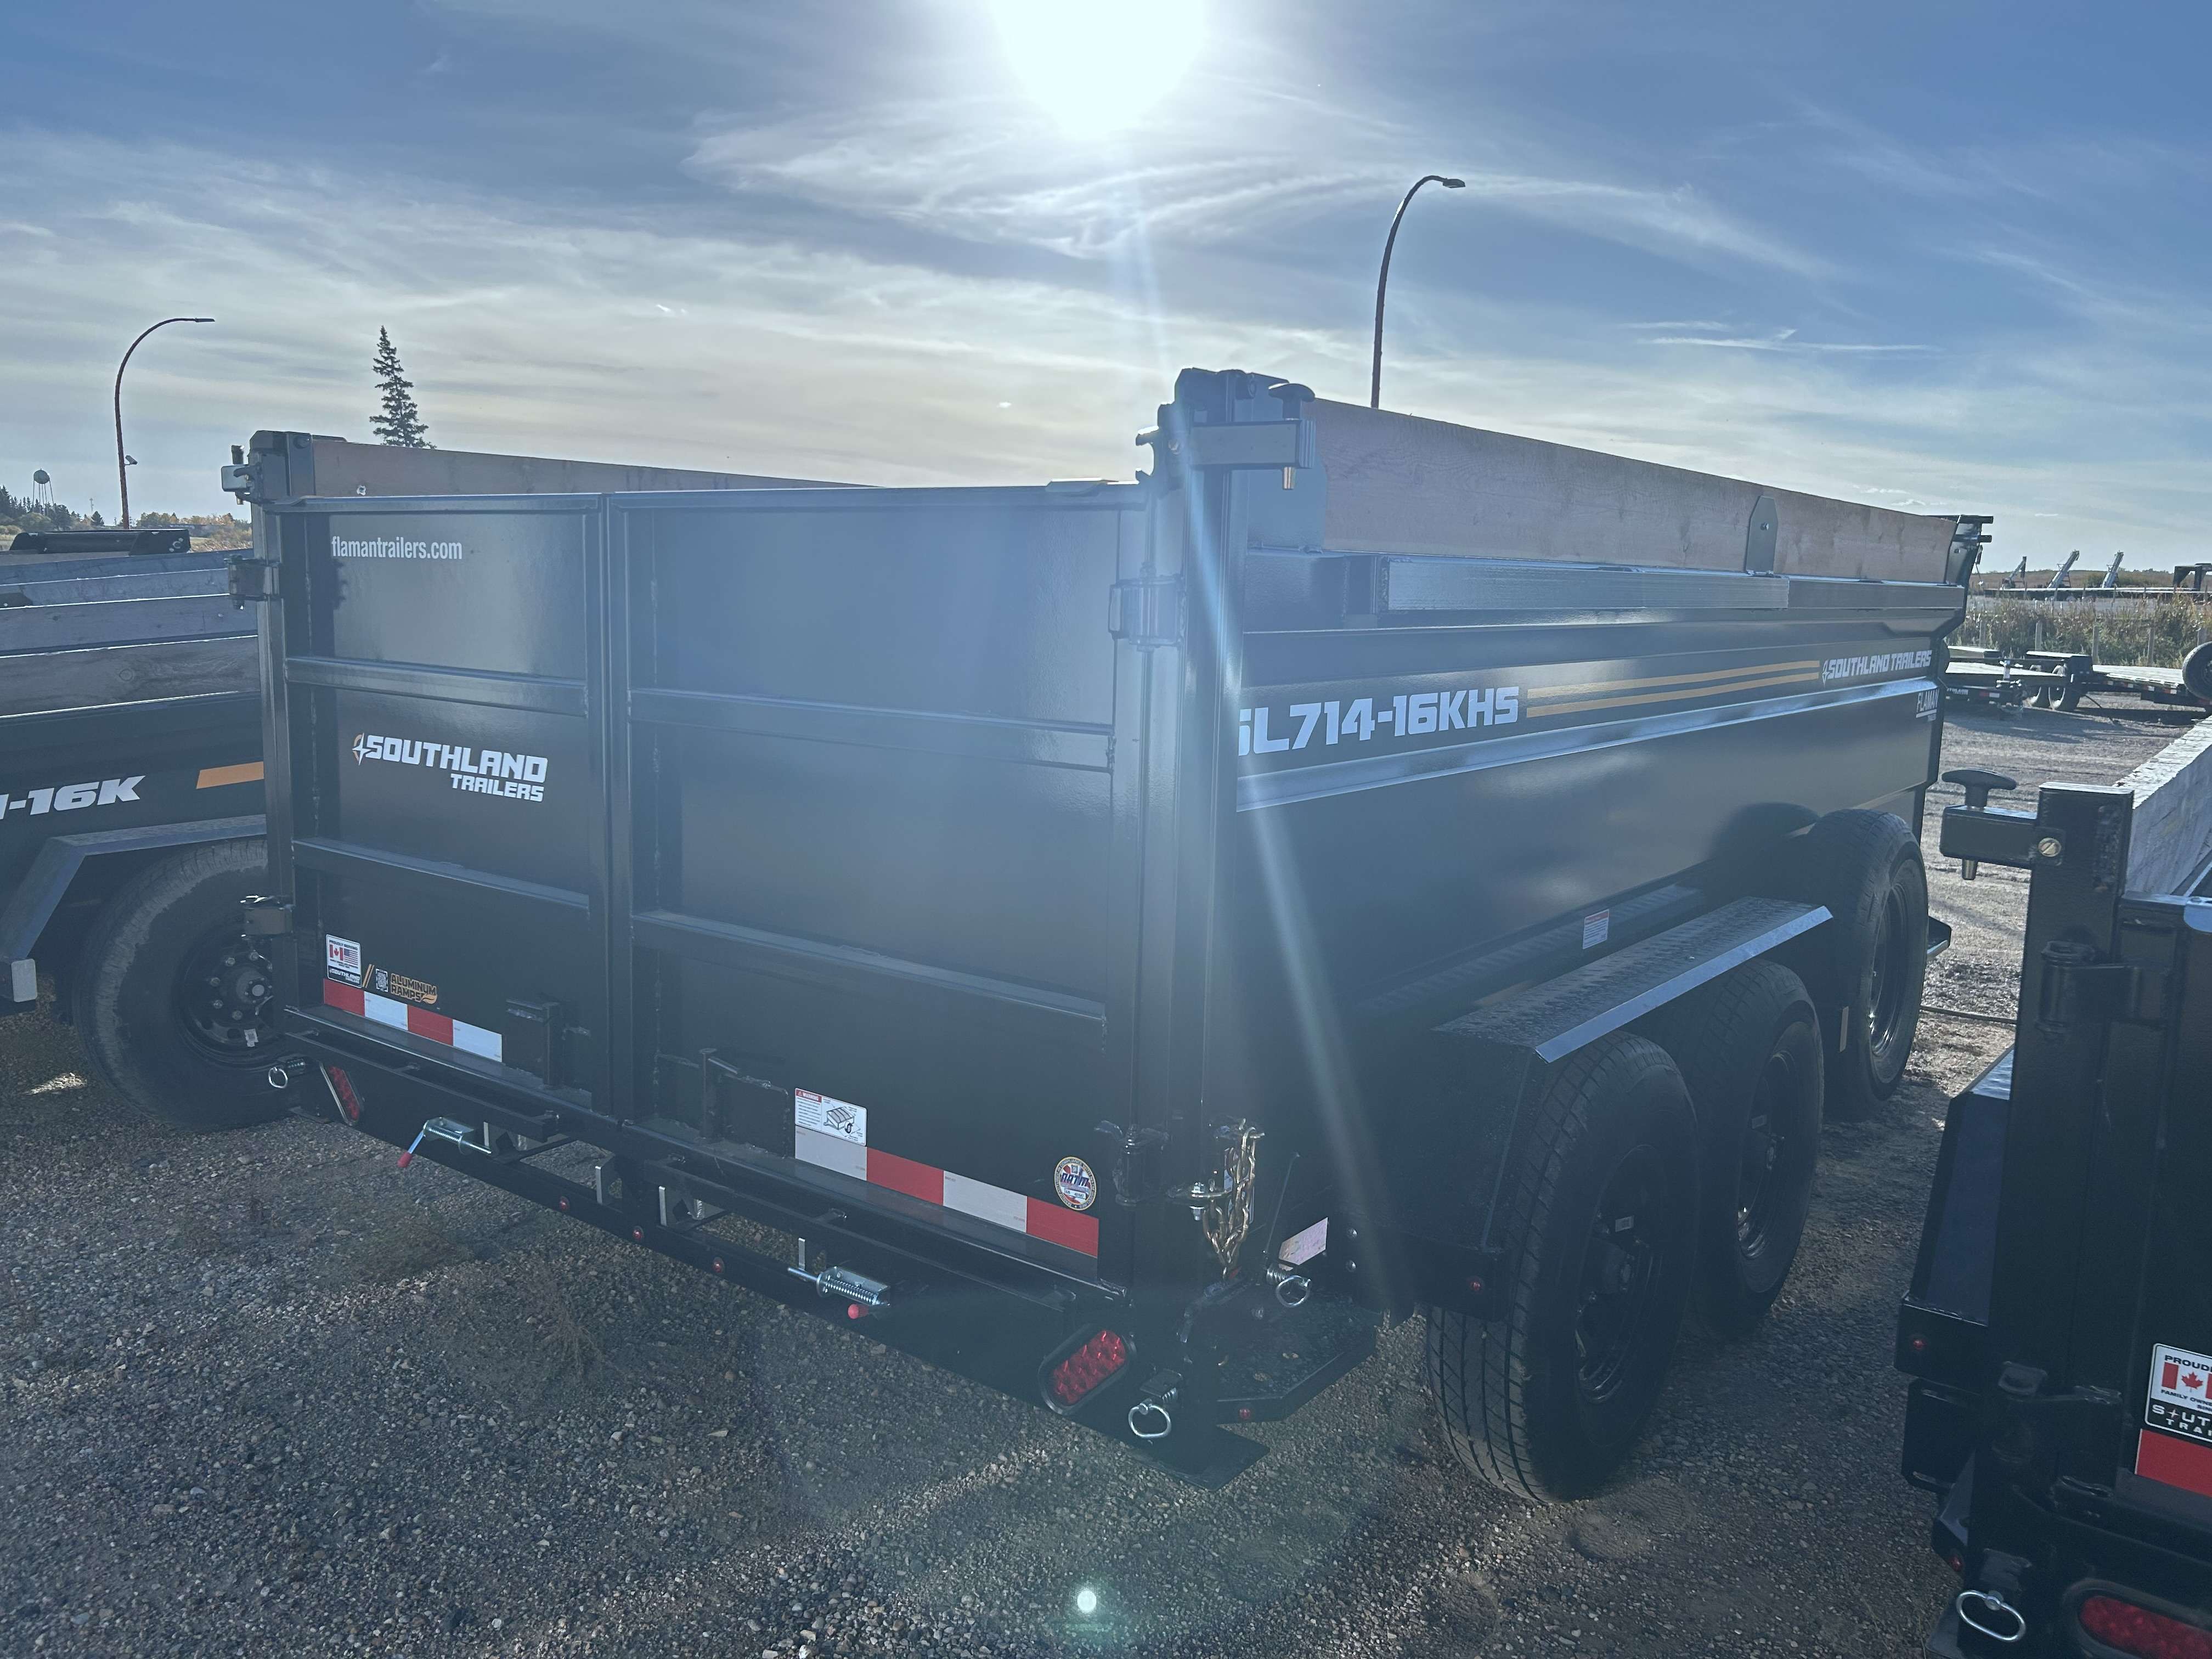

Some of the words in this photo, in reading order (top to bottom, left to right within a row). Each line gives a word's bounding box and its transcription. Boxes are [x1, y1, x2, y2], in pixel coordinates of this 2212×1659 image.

[331, 535, 462, 559] flamantrailers.com
[1827, 653, 1891, 680] SOUTHLAND
[1891, 650, 1932, 671] TRAILERS
[365, 735, 548, 783] SOUTHLAND
[0, 775, 146, 820] -16K
[450, 773, 545, 802] TRAILERS
[391, 973, 437, 995] ALUMINUM
[391, 983, 421, 1002] RAMPS
[2161, 1389, 2188, 1400] FAMILY
